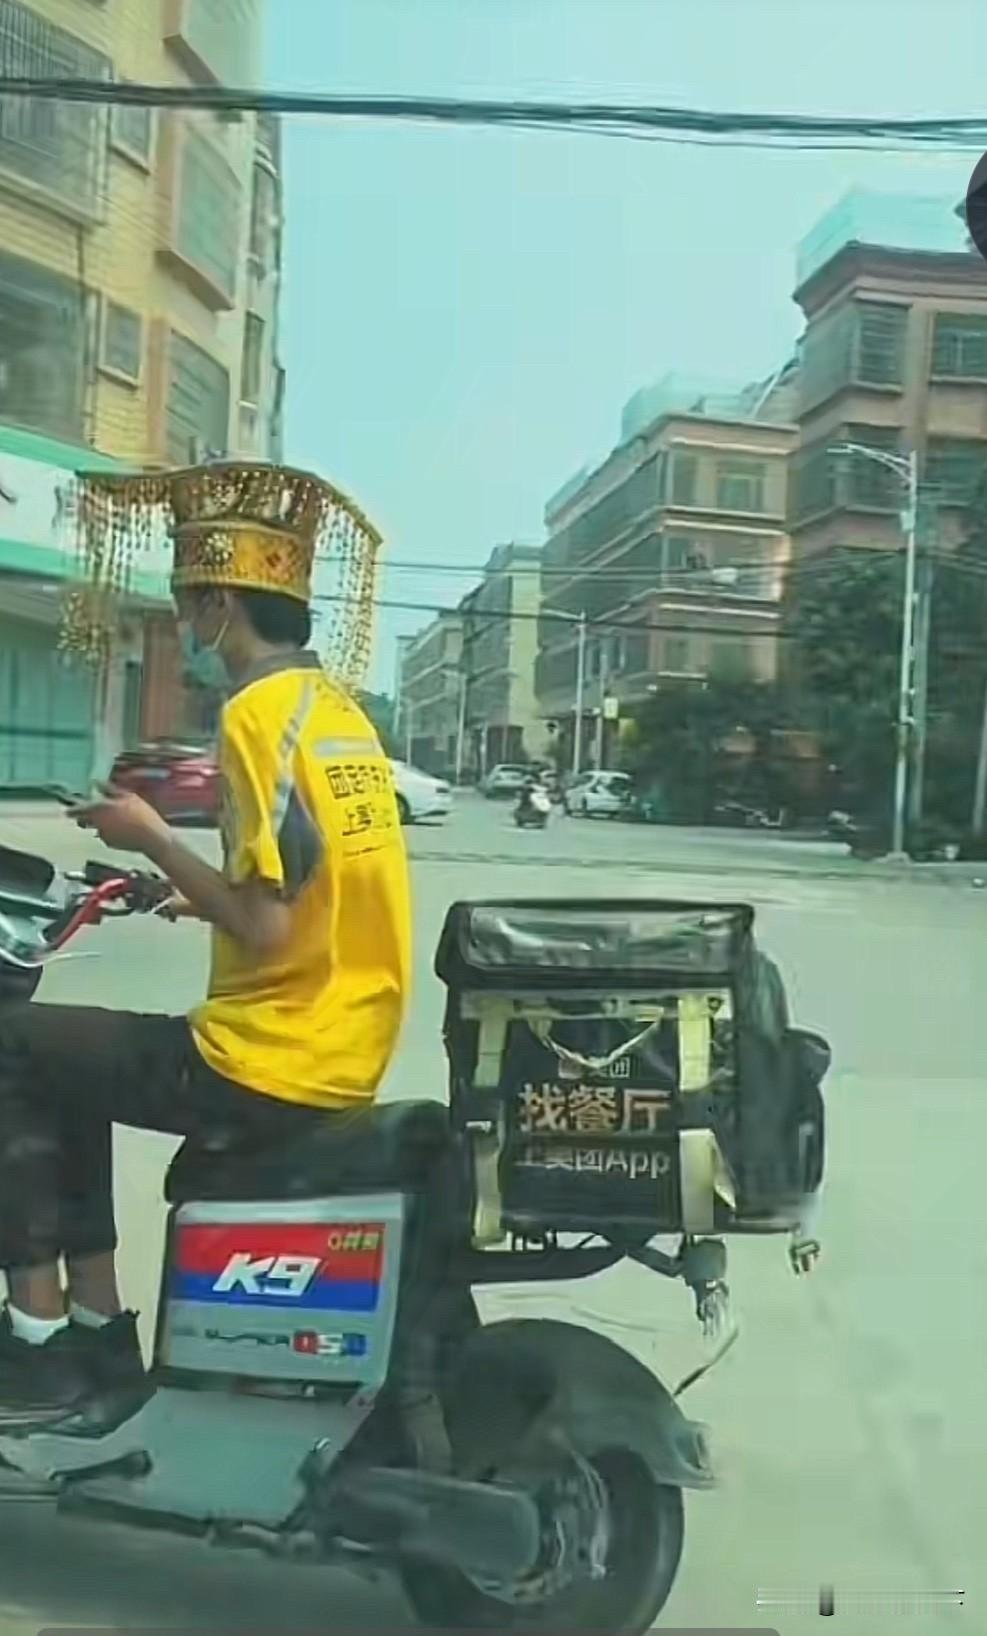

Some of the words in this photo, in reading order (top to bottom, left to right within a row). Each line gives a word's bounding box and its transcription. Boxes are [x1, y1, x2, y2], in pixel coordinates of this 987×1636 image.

[518, 1082, 672, 1136] 找餐厅
[212, 1252, 322, 1297] K9
